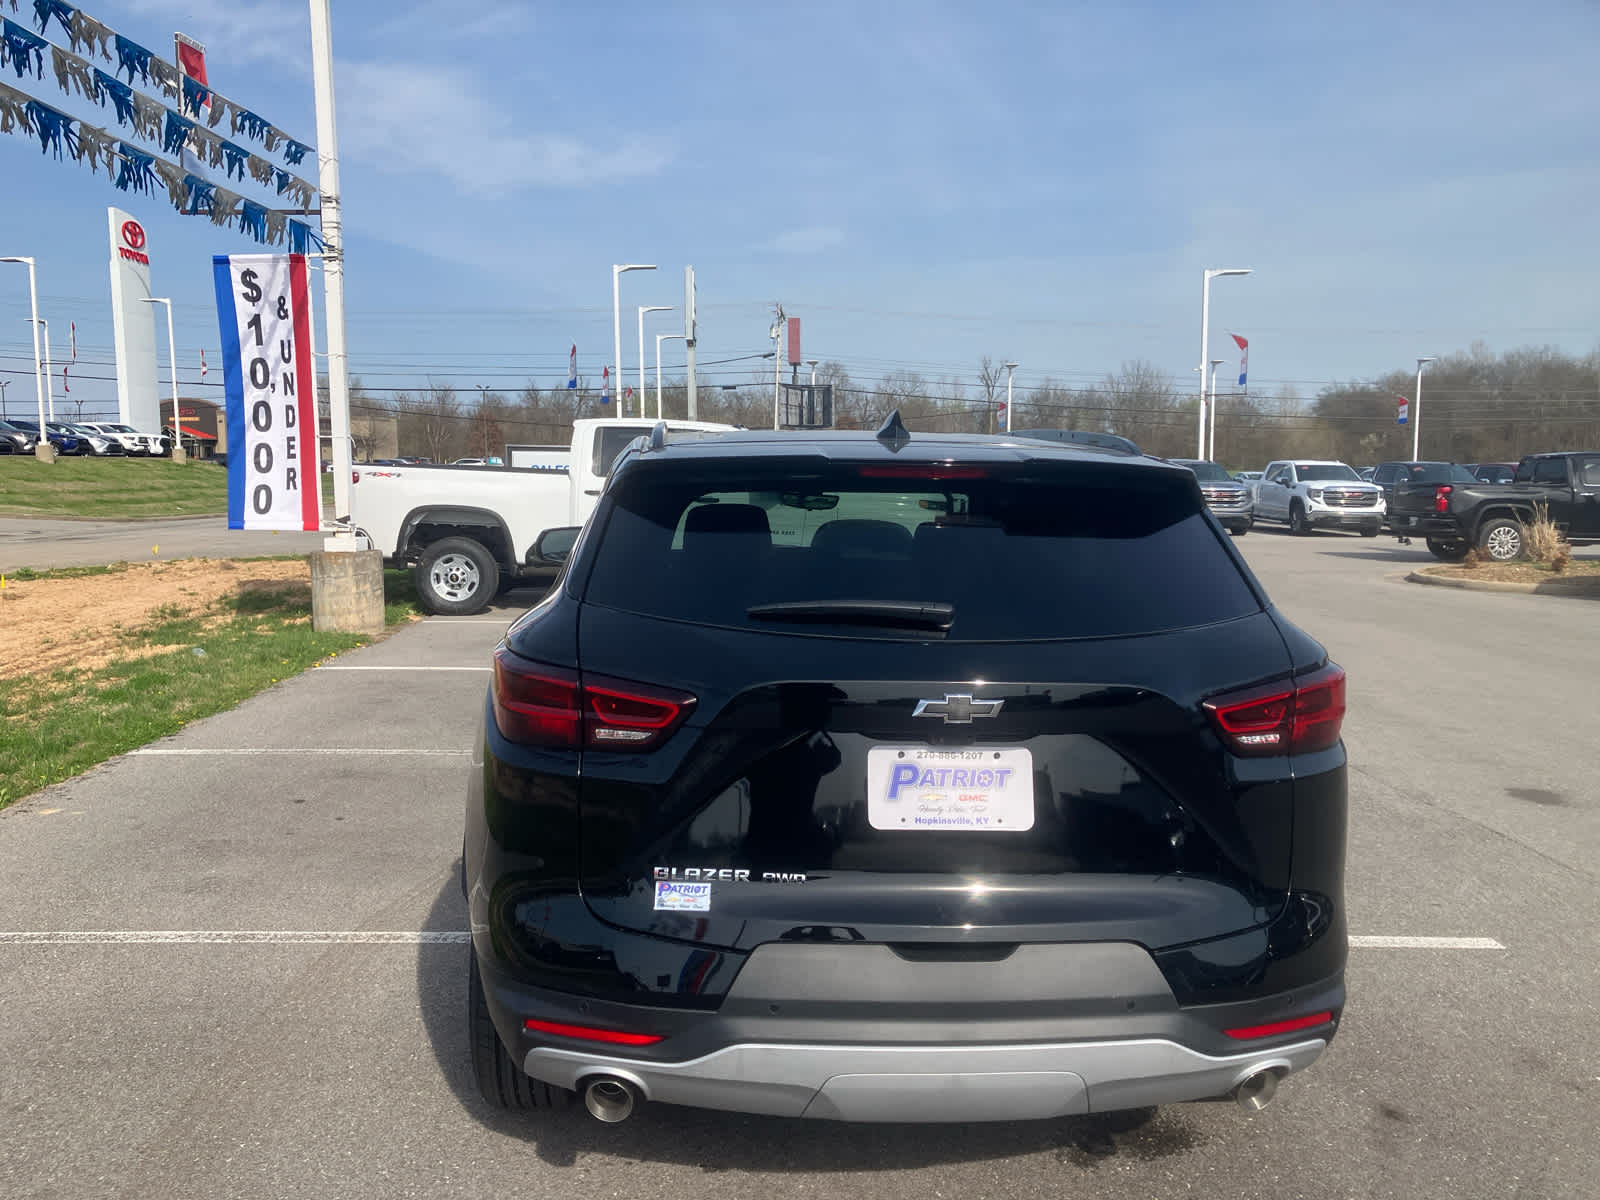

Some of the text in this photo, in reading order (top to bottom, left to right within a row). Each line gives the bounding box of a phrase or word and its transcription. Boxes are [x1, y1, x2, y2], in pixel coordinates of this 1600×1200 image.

[118, 246, 149, 265] TOYOTA
[240, 268, 276, 515] $10,000
[277, 295, 298, 491] & UNDER
[887, 763, 1012, 800] PATRIOT
[654, 867, 750, 882] BLAZER
[658, 882, 708, 896] PATRIOT
